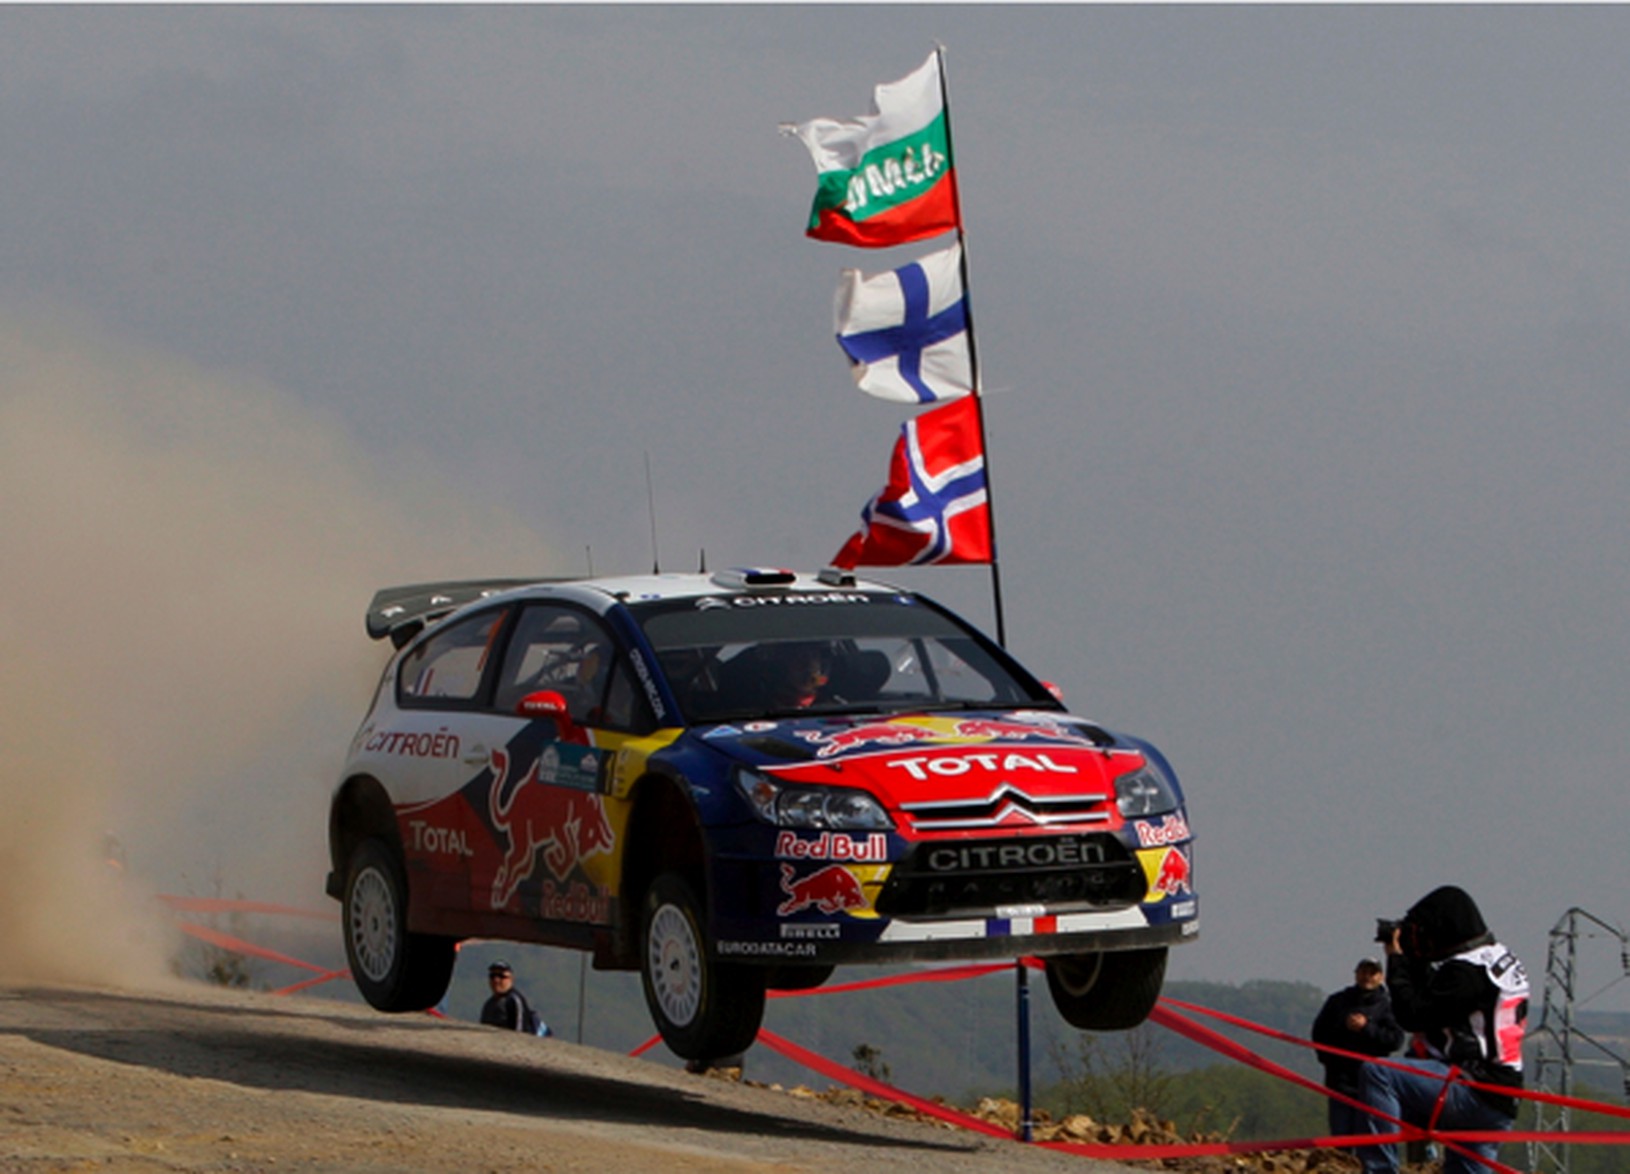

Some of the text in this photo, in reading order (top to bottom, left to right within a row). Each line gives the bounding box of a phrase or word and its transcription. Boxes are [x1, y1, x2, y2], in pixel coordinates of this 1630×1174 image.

[887, 754, 1079, 781] TOTAL
[409, 821, 474, 856] TOTAL
[775, 831, 887, 861] Red Bull
[780, 923, 840, 938] PIRELLI
